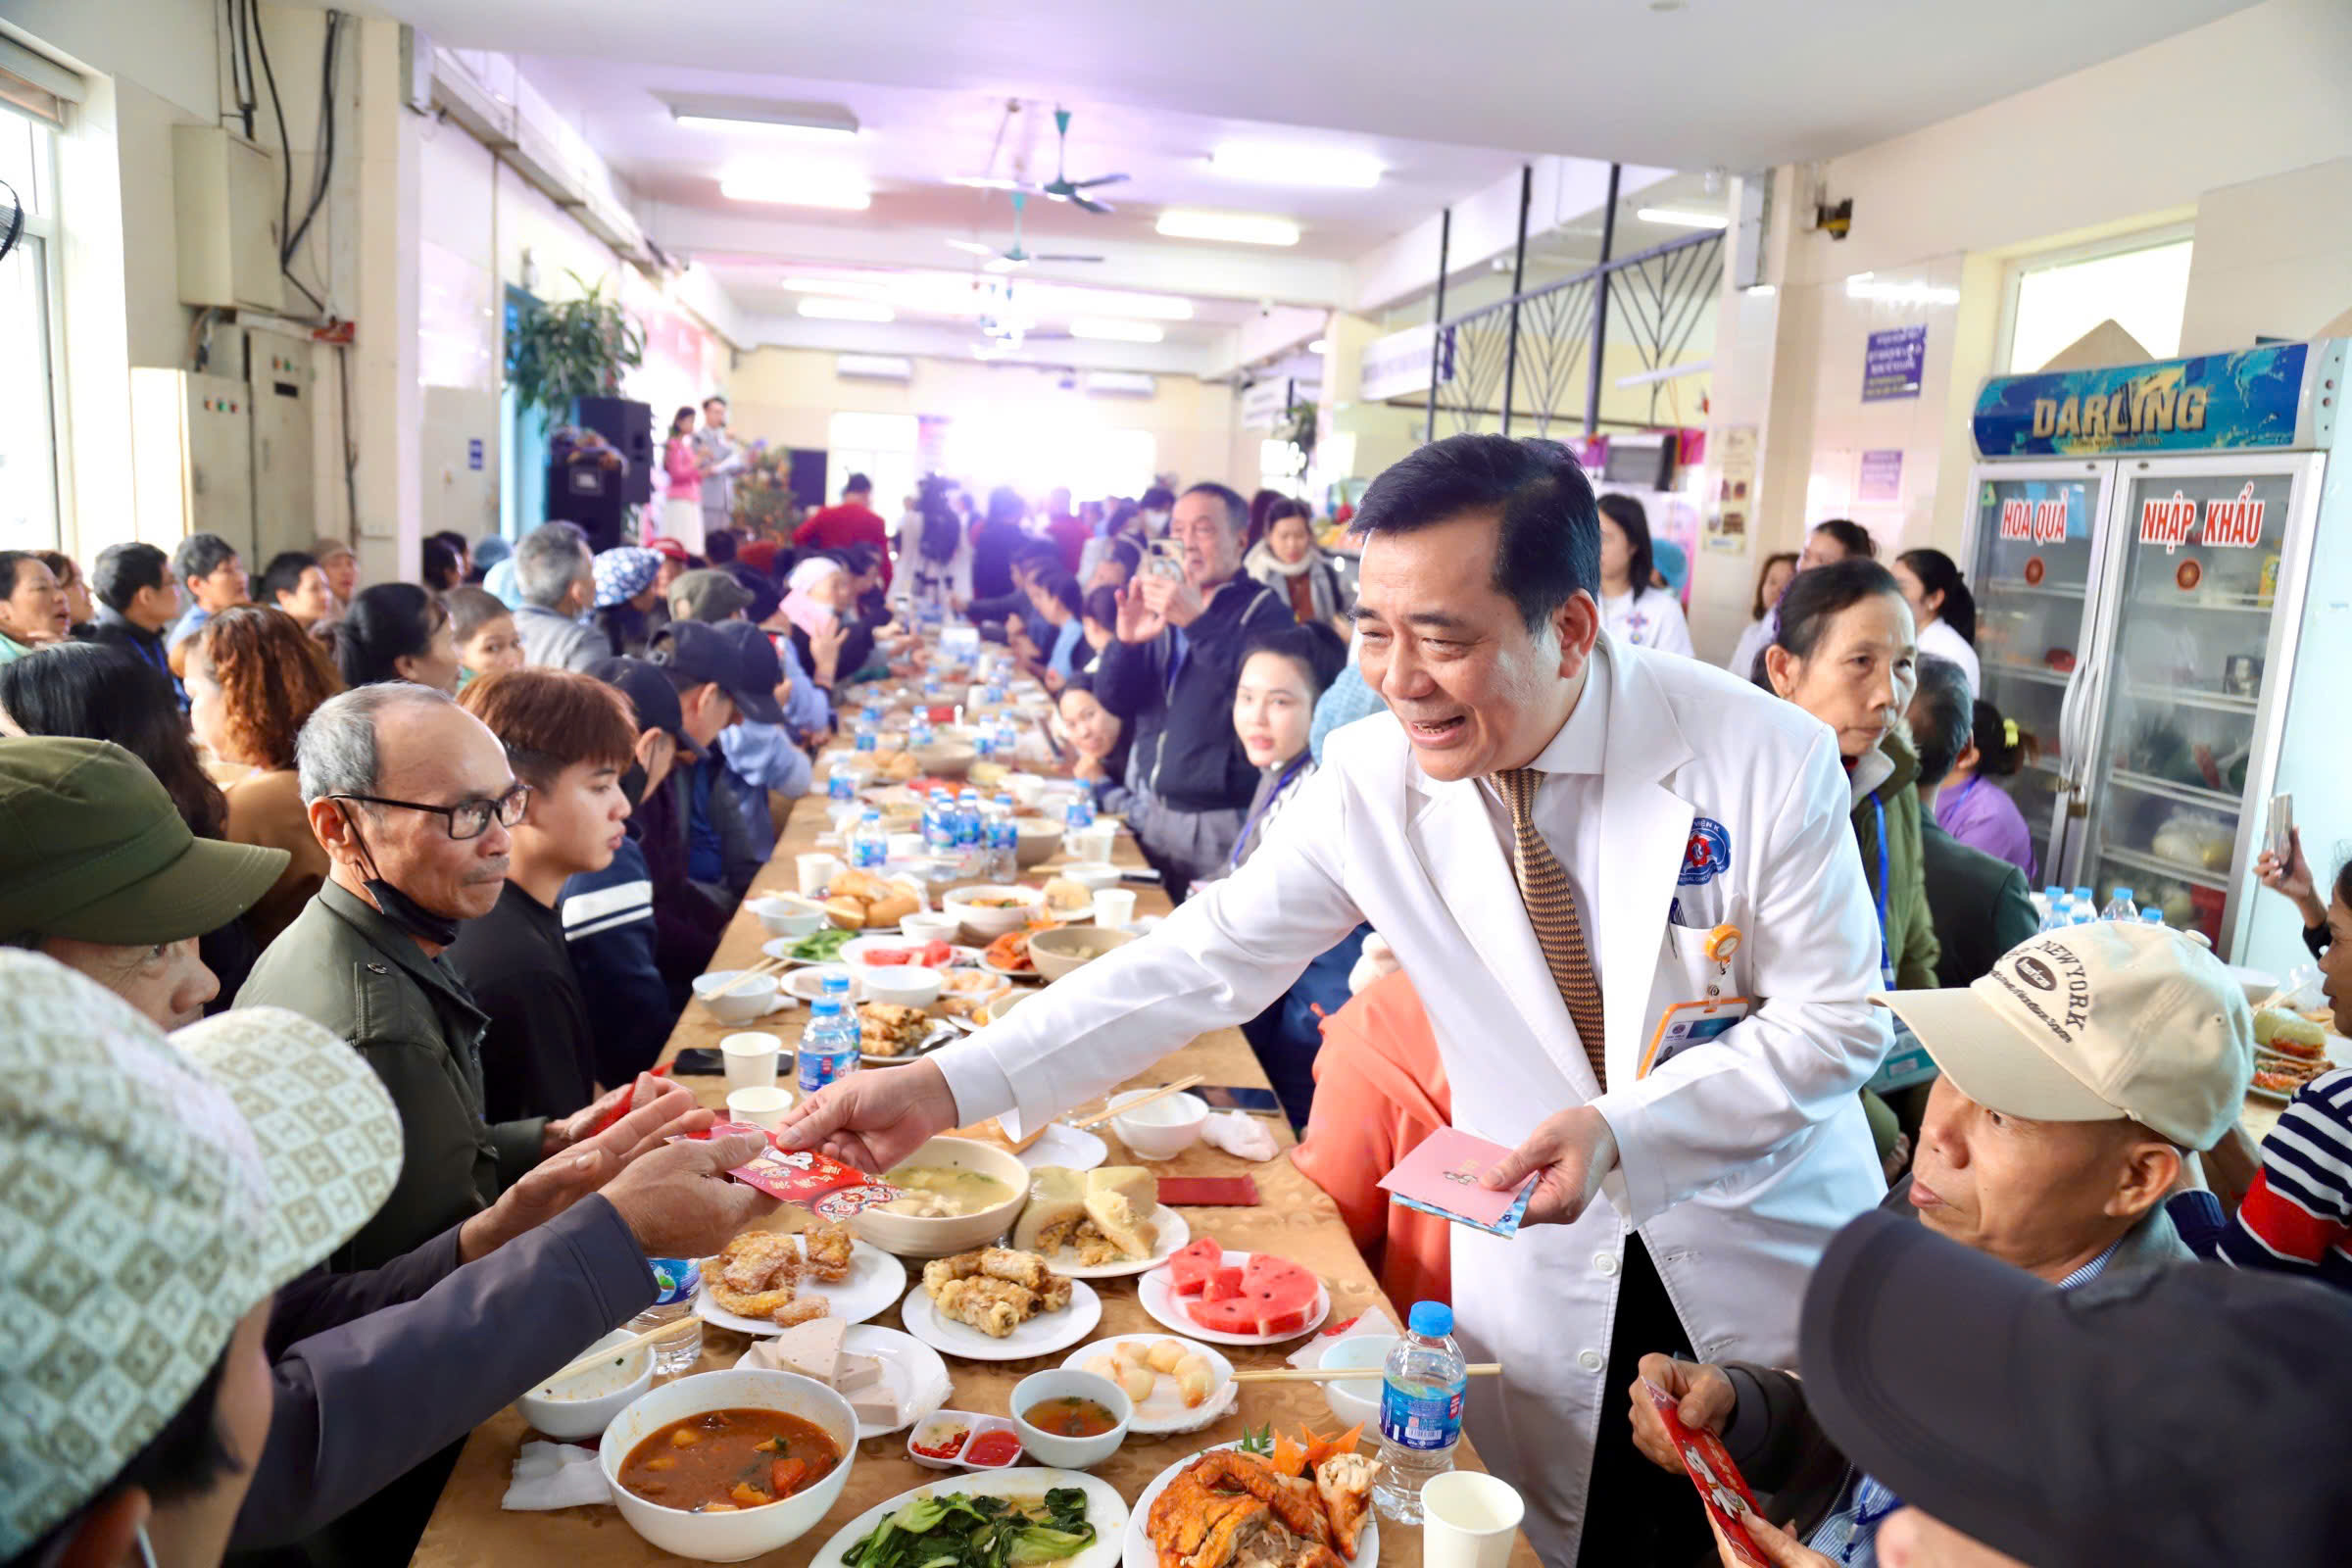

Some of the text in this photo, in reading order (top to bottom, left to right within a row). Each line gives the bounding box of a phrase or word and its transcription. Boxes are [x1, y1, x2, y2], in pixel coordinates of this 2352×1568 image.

[2033, 387, 2207, 437] DARLING
[2000, 481, 2264, 554] HOA QUẢ NHẬP KHẨU
[2035, 941, 2088, 1031] NEW YORK
